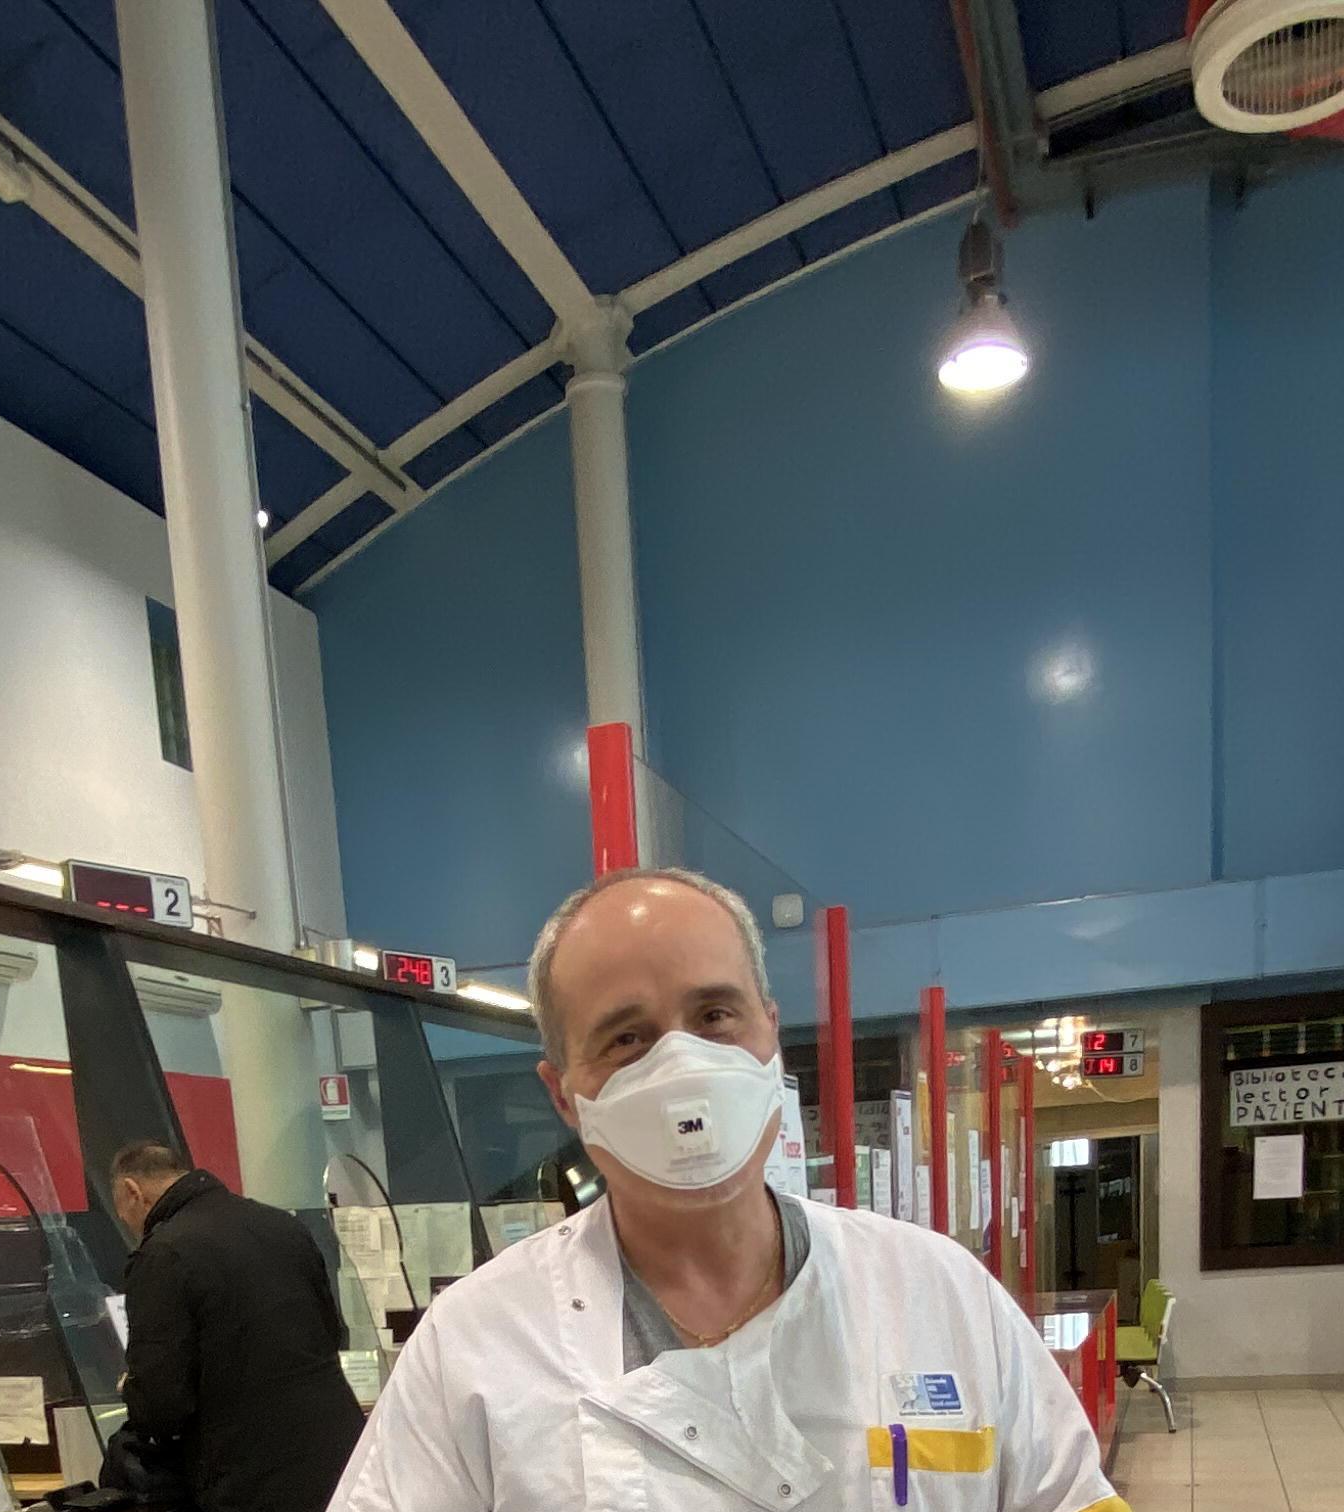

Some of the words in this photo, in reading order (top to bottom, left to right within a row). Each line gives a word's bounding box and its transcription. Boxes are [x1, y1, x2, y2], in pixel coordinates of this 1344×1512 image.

[164, 887, 180, 917] 2
[440, 966, 451, 987] 3
[1130, 1034, 1138, 1048] 7
[1129, 1058, 1138, 1072] 8
[677, 1117, 704, 1135] 3M
